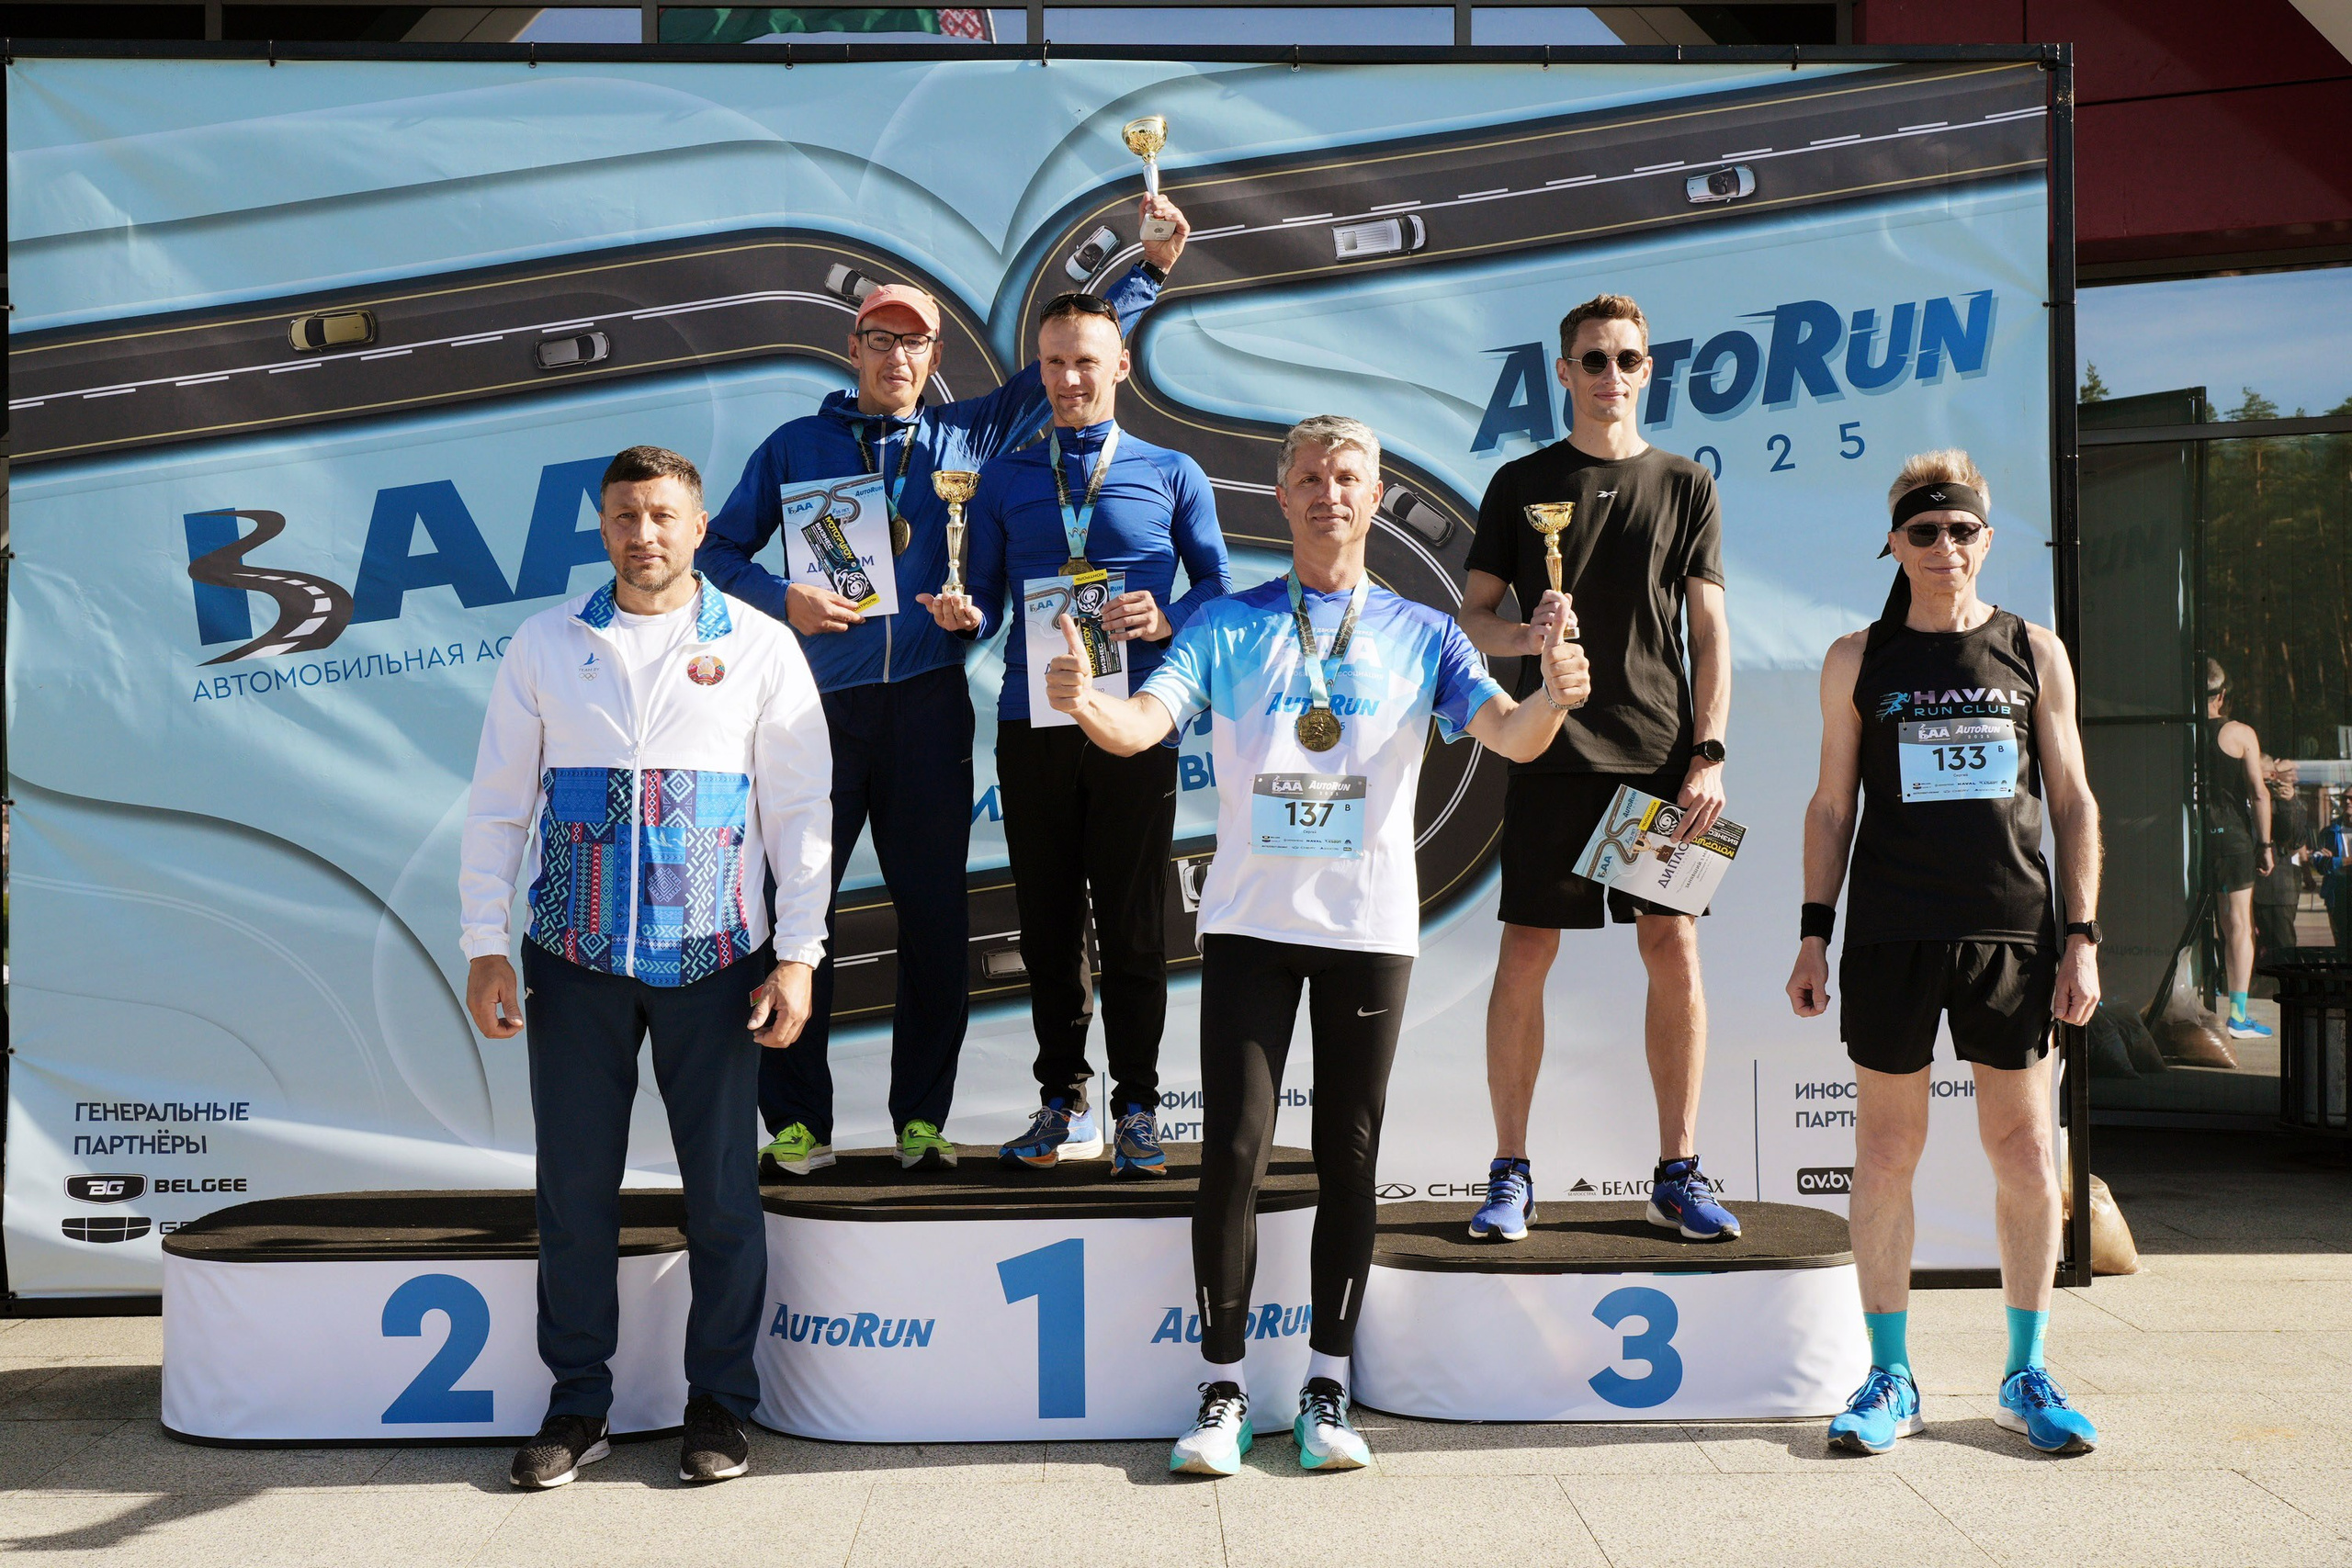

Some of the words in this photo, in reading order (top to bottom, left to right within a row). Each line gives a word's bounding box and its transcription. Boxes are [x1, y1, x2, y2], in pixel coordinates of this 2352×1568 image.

[1469, 288, 1996, 455] ATORUN
[854, 485, 883, 497] AUTORUN
[815, 522, 833, 550] БИЗНЕС
[851, 596, 877, 613] ОНТРОЛЬ
[193, 643, 464, 703] АВТОМОБИЛЬНАЯ
[1265, 692, 1381, 716] AUTRUN
[1914, 687, 2026, 706] HAVAL
[1915, 706, 1952, 716] RUN
[1962, 705, 2011, 716] CLUB
[1955, 724, 2001, 735] AUTORUN
[1932, 745, 1987, 772] 133
[1308, 779, 1351, 792] AUTORUN
[1284, 801, 1335, 828] 137
[1623, 790, 1637, 819] AUTORUN
[1657, 841, 1690, 889] ДИПЛО
[75, 1102, 250, 1122] ГЕНЕРАЛЬНЫЕ
[74, 1129, 208, 1156] ПАРТНЁРЫ
[153, 1179, 247, 1193] BELGEE
[768, 1301, 935, 1348] AUTORUN
[997, 1237, 1086, 1419] 1
[381, 1273, 494, 1425] 2
[1589, 1286, 1683, 1409] 3
